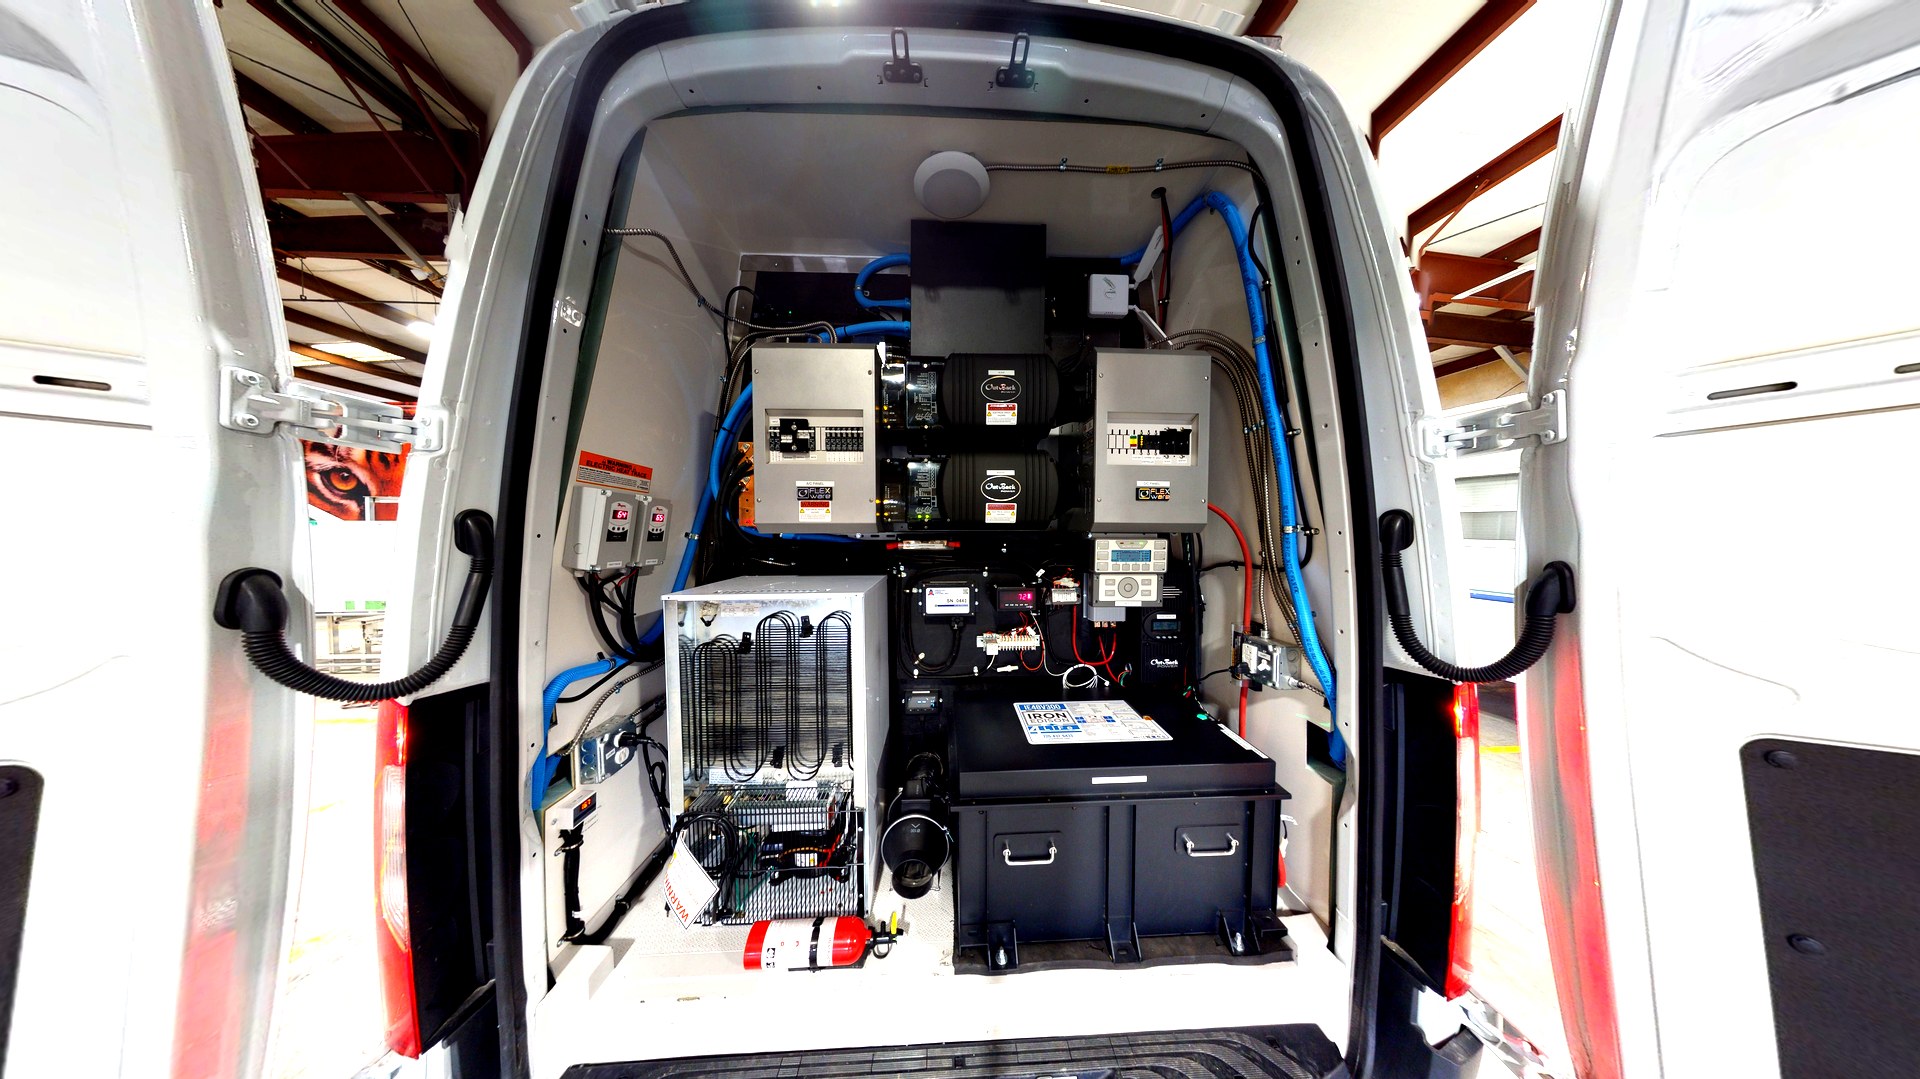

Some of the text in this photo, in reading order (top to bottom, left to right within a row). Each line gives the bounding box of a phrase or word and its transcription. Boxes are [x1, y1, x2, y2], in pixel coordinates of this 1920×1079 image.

[586, 460, 647, 478] ELECTRIC HEAT TRACE
[607, 459, 633, 469] WARNING
